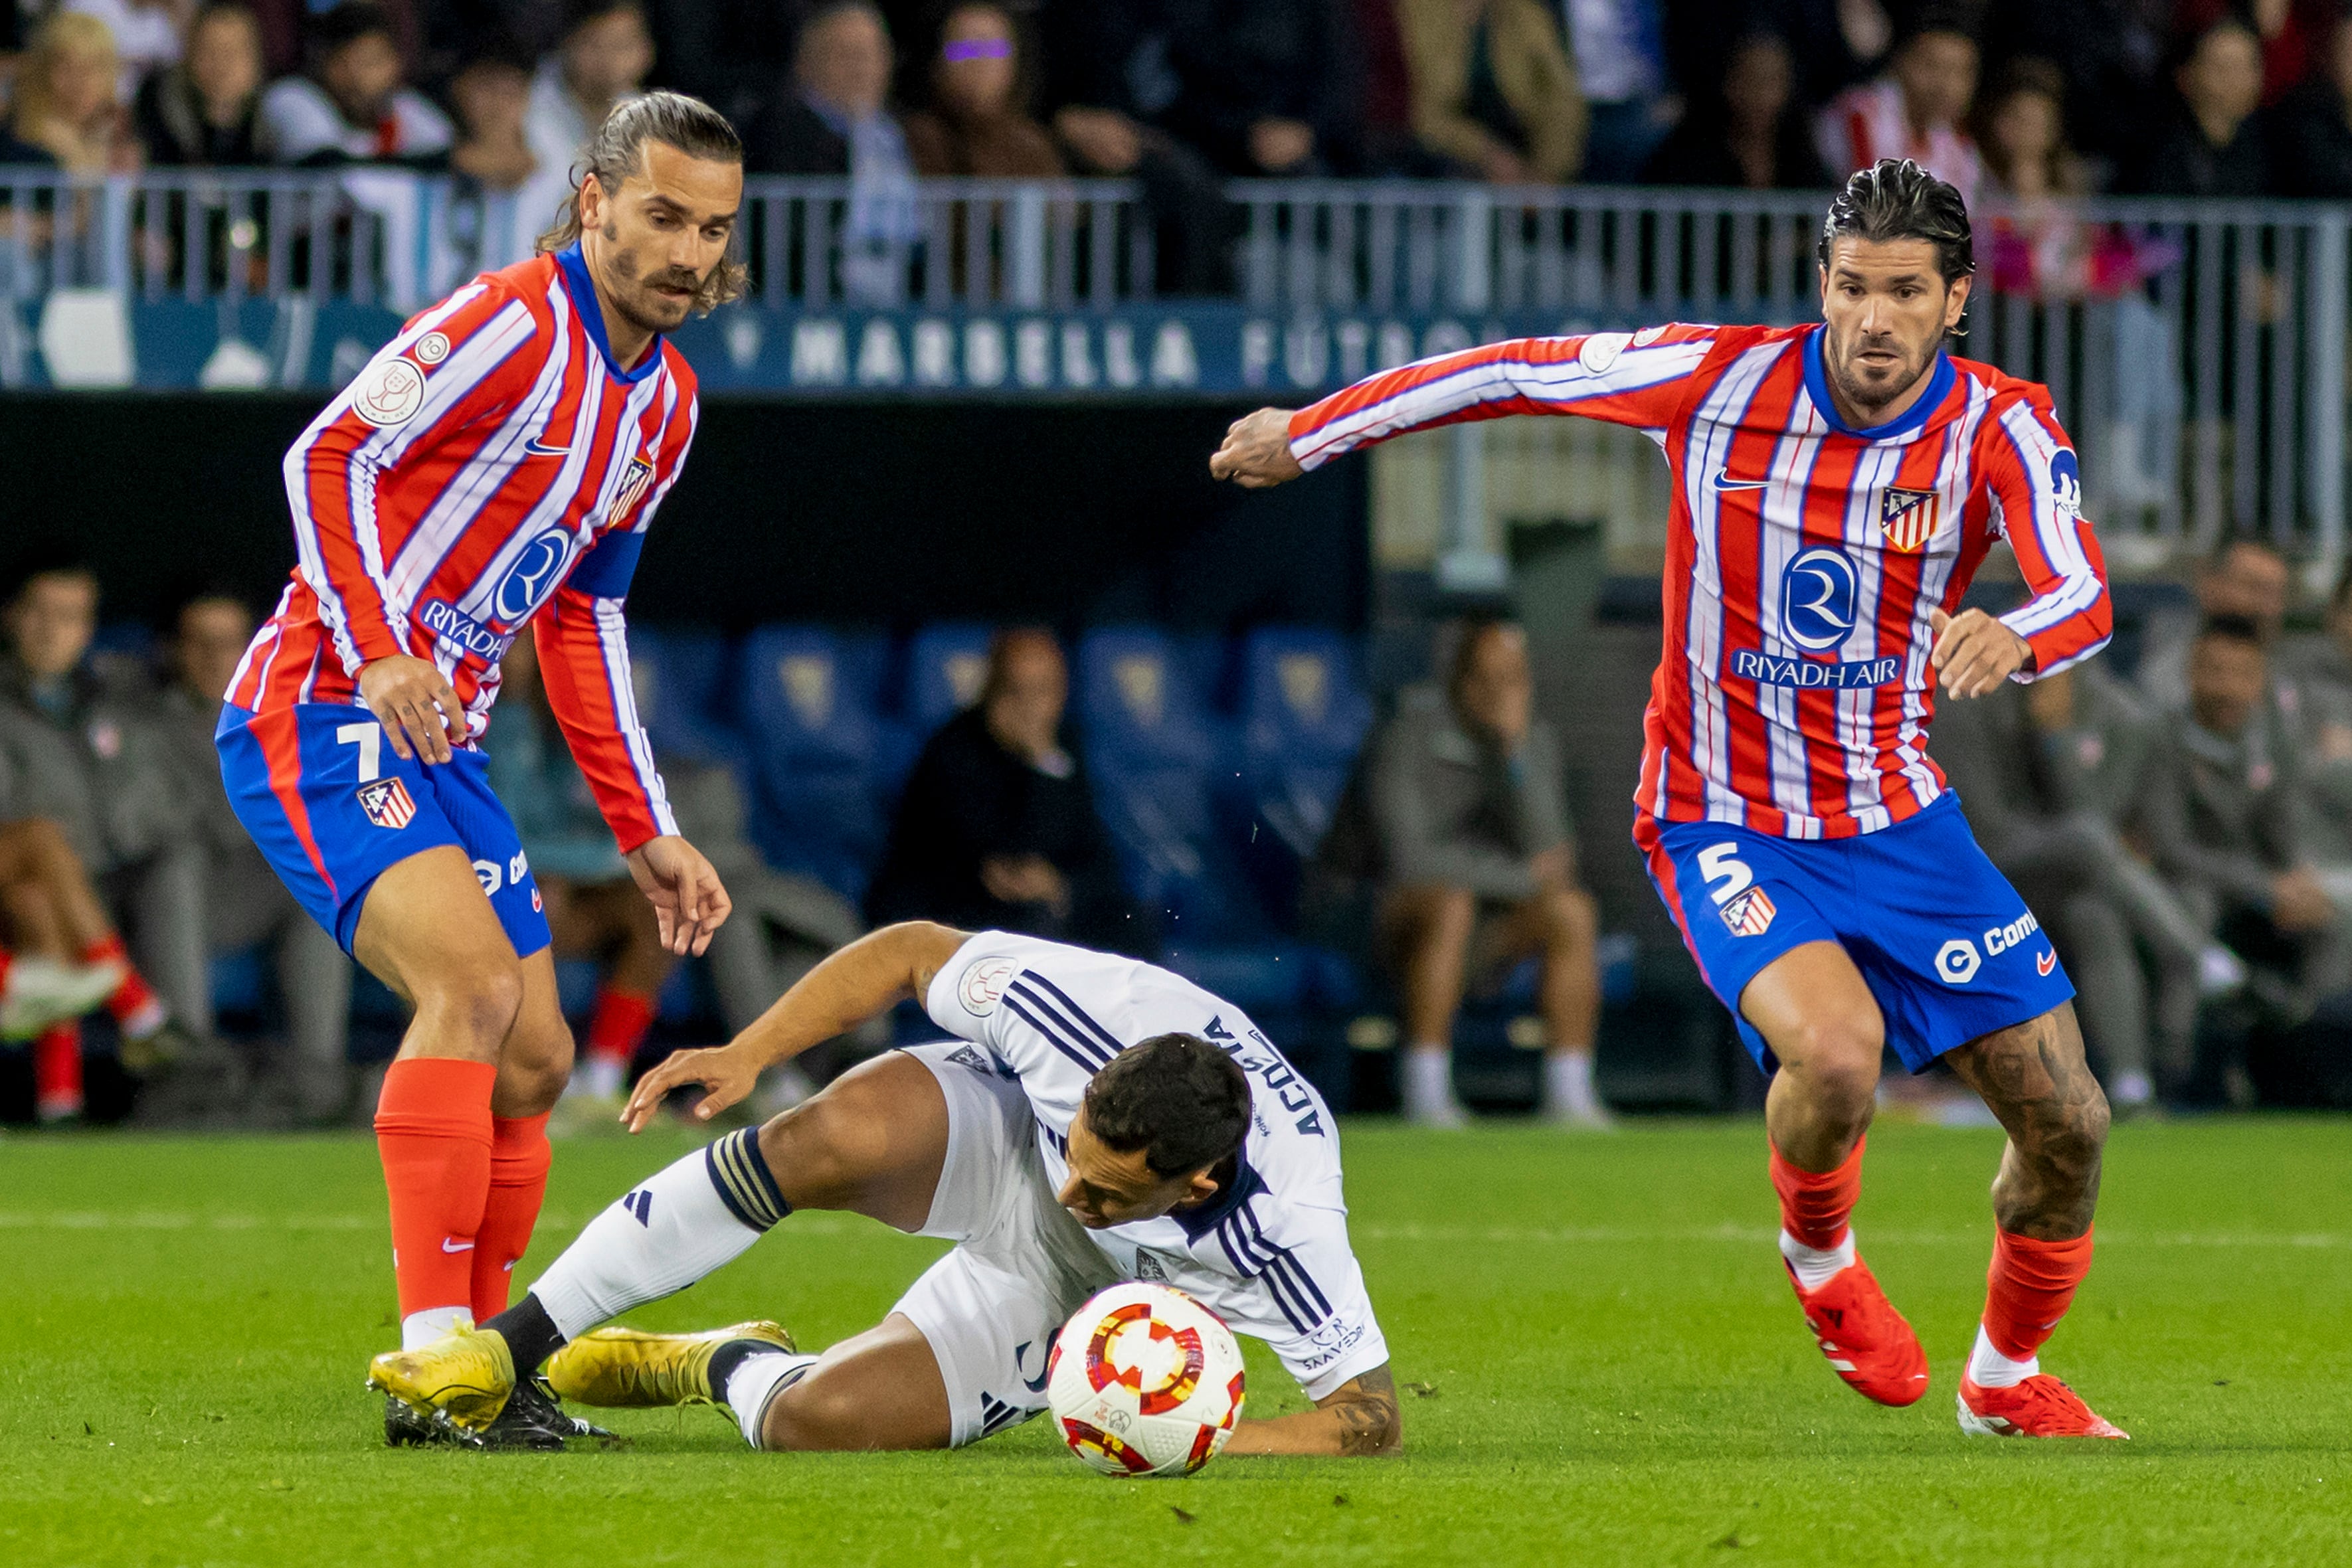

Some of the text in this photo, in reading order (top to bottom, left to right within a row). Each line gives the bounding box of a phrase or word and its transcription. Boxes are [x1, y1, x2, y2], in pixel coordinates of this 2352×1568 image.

[426, 339, 441, 355] 10
[792, 319, 1199, 389] MARBELLA
[424, 600, 507, 661] RIYADH
[1738, 652, 1896, 687] RIYADH AIR
[337, 721, 381, 783] 7
[1697, 841, 1754, 906] 5
[1983, 910, 2038, 956] Com
